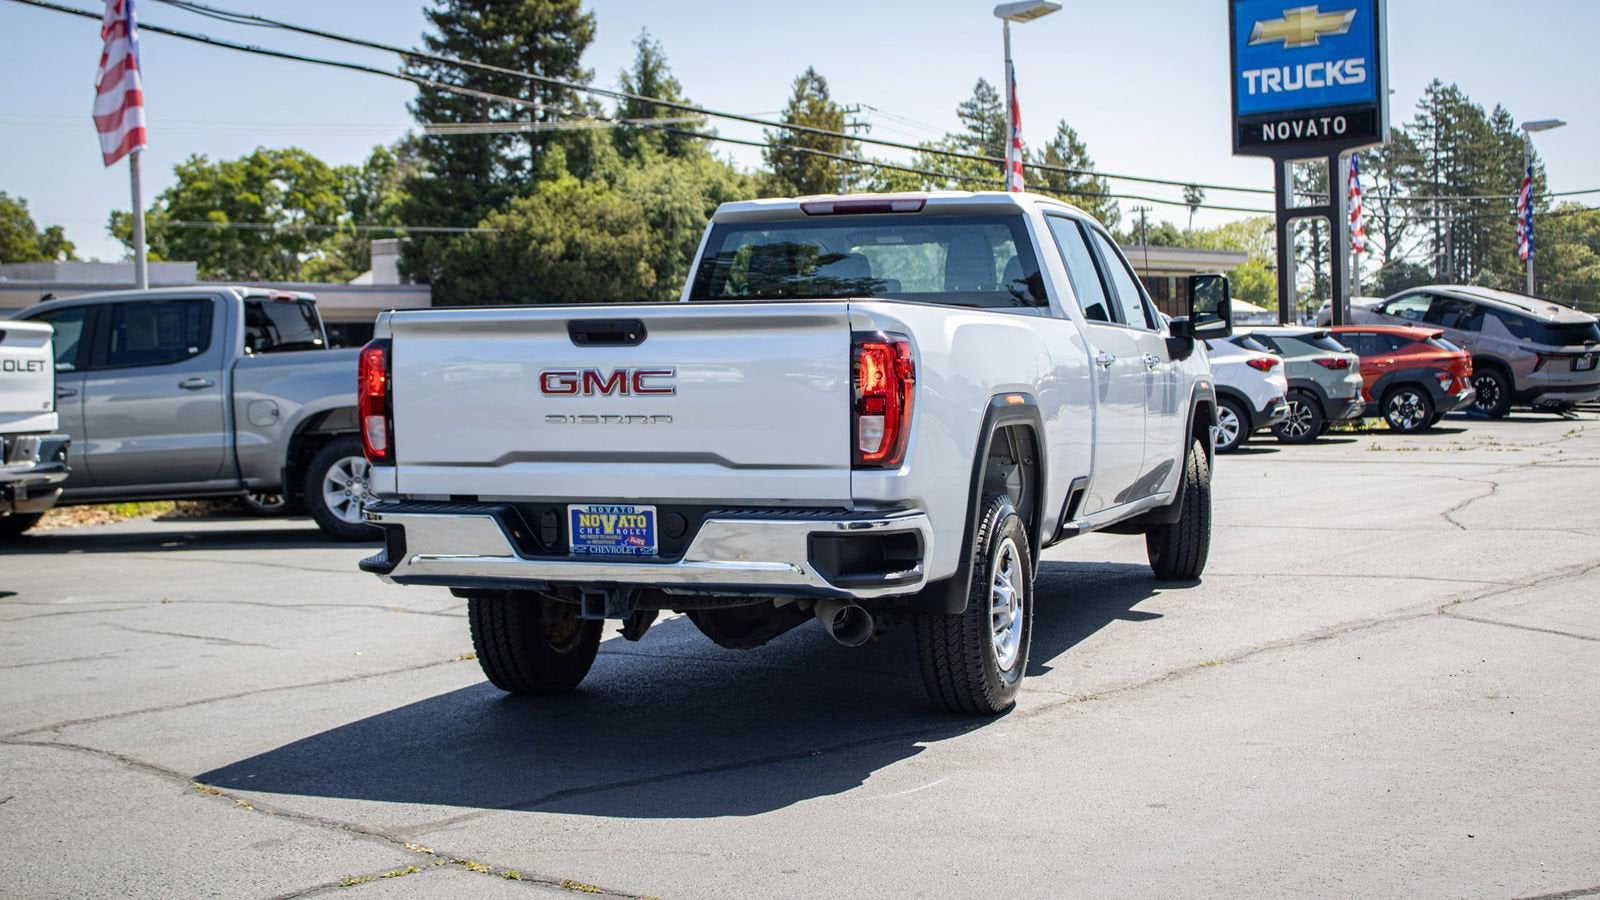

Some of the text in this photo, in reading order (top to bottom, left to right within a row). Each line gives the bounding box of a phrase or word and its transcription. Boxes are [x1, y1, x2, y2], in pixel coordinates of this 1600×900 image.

[1242, 57, 1367, 95] TRUCKS
[1262, 115, 1347, 141] NOVATO
[0, 359, 46, 372] OLET
[539, 366, 677, 396] GMC
[544, 414, 673, 425] SIERRA
[579, 514, 647, 534] NOVATO
[589, 546, 637, 554] CHEVROLET
